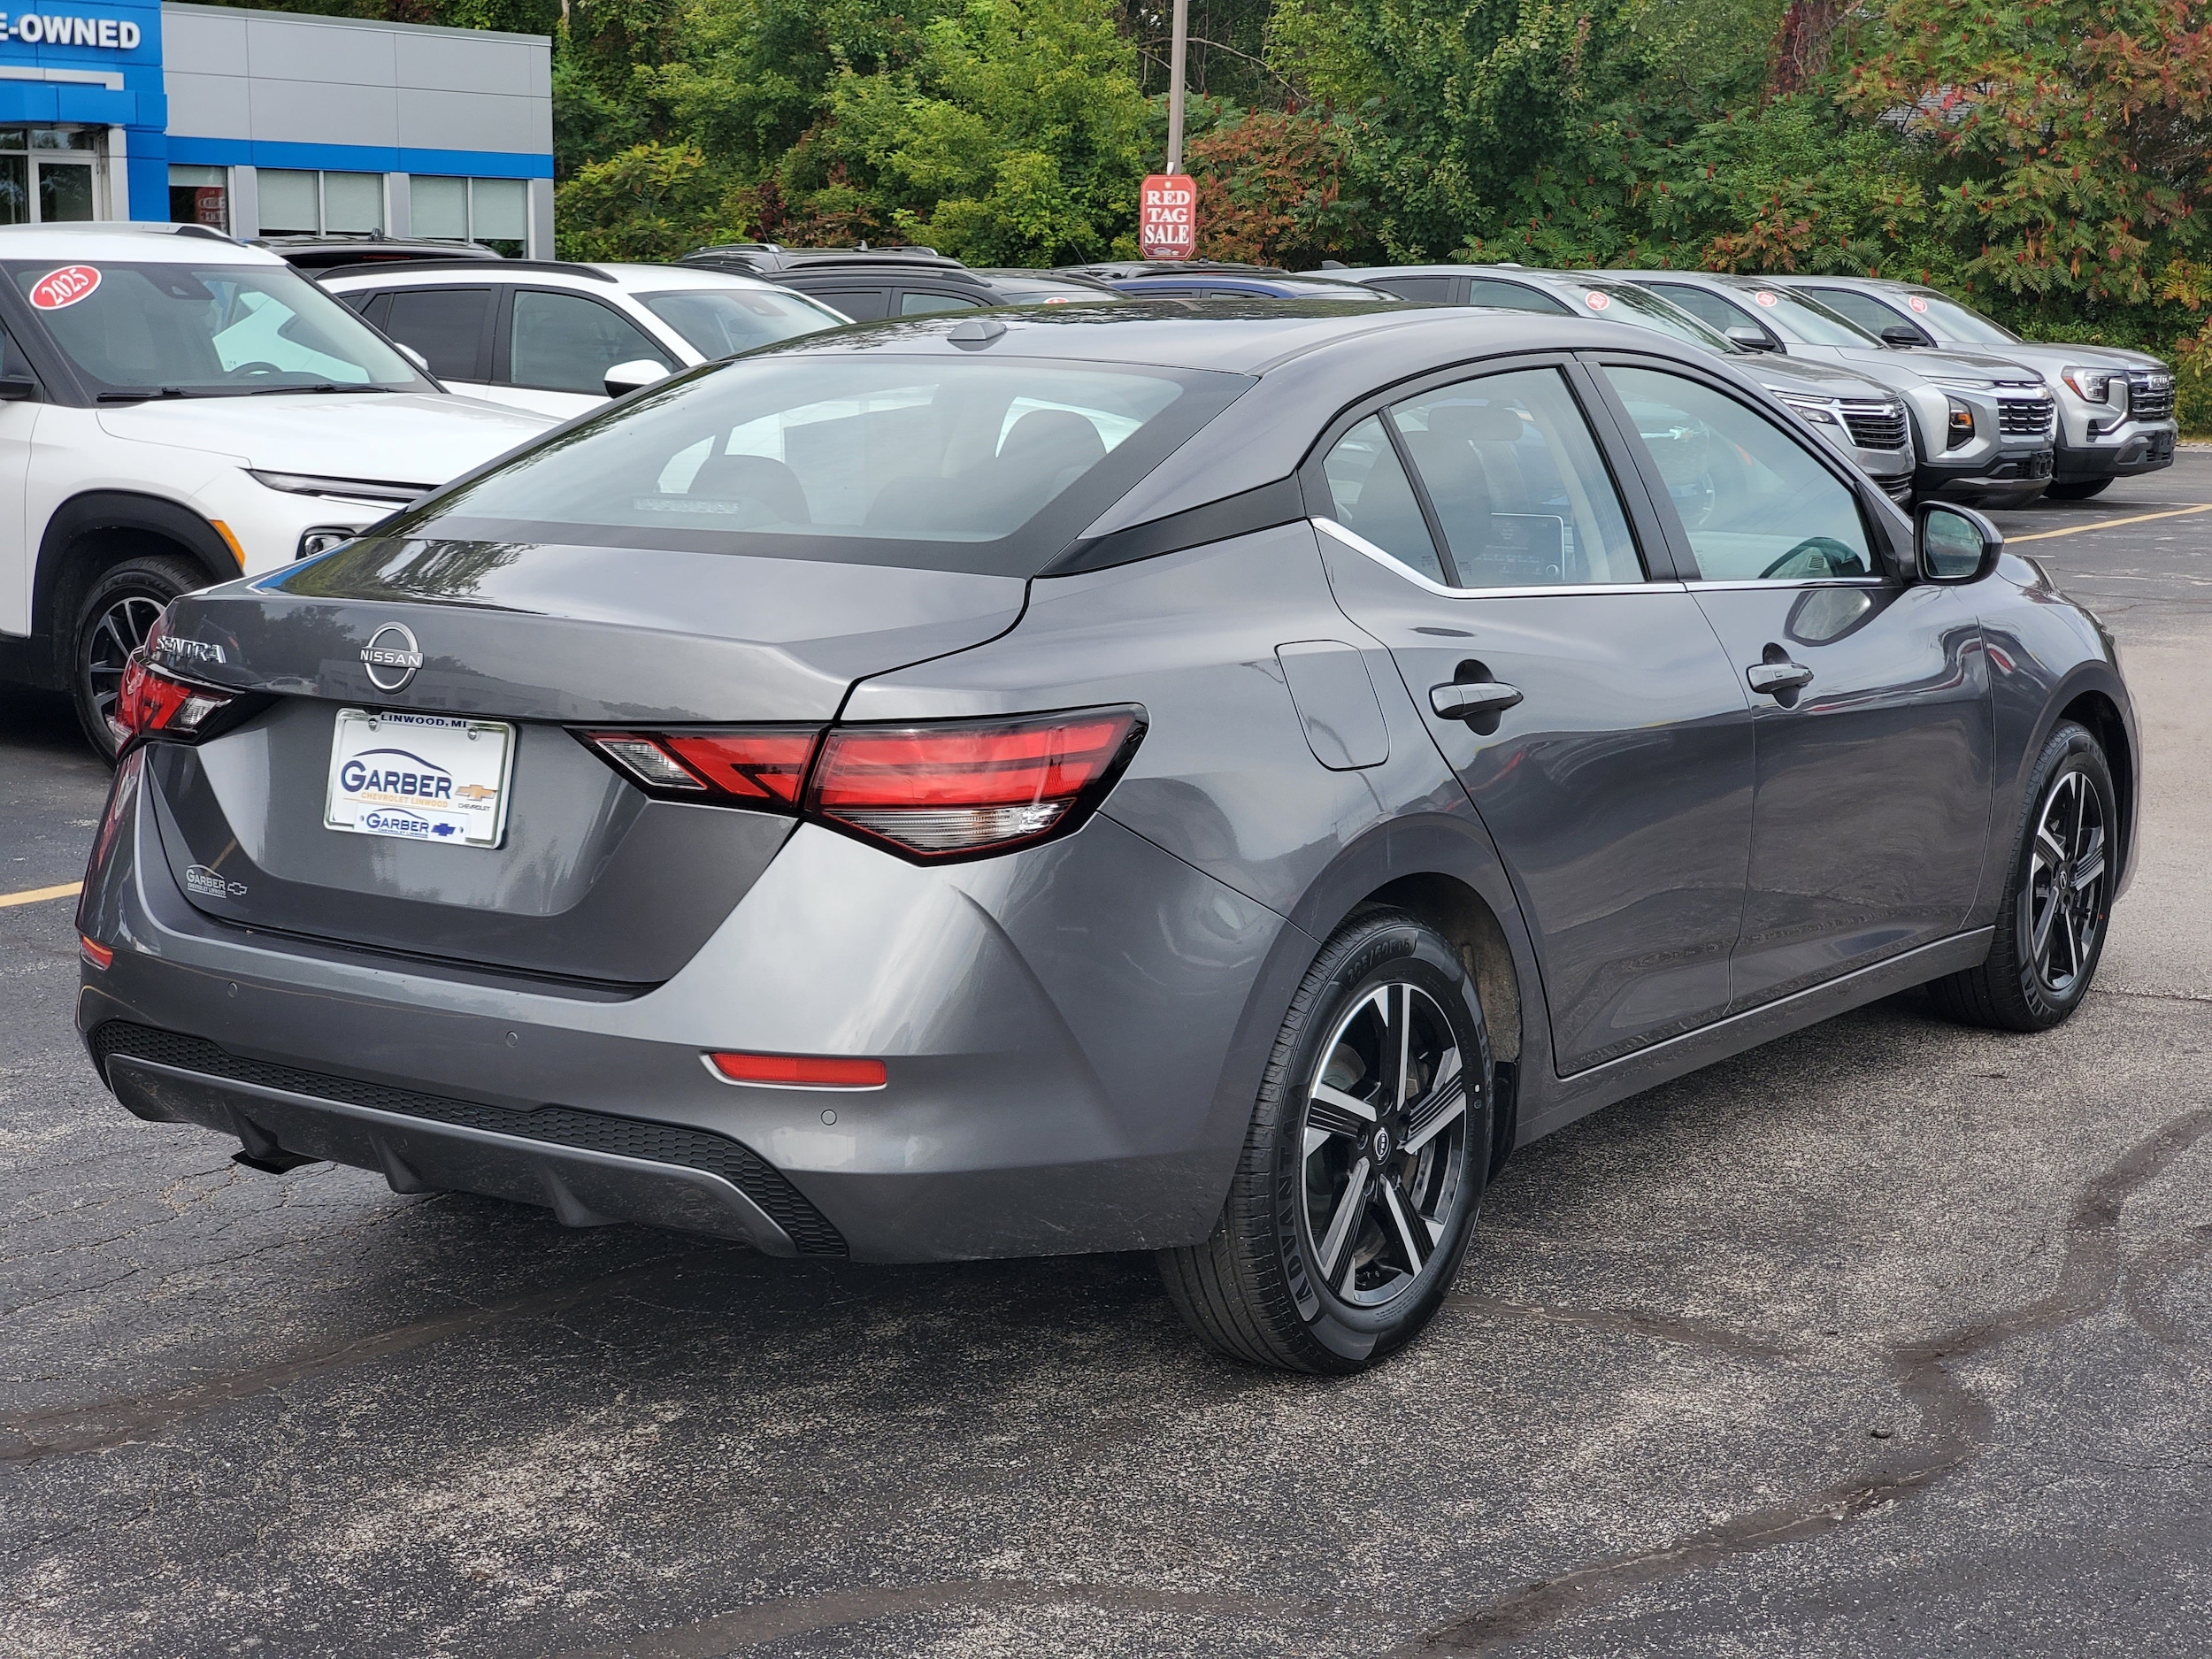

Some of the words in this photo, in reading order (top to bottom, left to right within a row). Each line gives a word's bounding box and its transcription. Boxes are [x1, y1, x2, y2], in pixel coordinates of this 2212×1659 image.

[1145, 189, 1191, 206] RED
[1147, 207, 1189, 224] TAG
[1144, 223, 1190, 245] SALE
[41, 268, 89, 305] 2025
[156, 635, 227, 664] SENTRA
[360, 649, 420, 666] NISSAN
[341, 759, 452, 800] GARBER
[361, 792, 409, 804] CHEVROLET
[411, 798, 449, 809] LINWOOD
[457, 803, 491, 811] CHEVROLET
[366, 812, 430, 833] GARBER
[186, 869, 226, 890] GARBER
